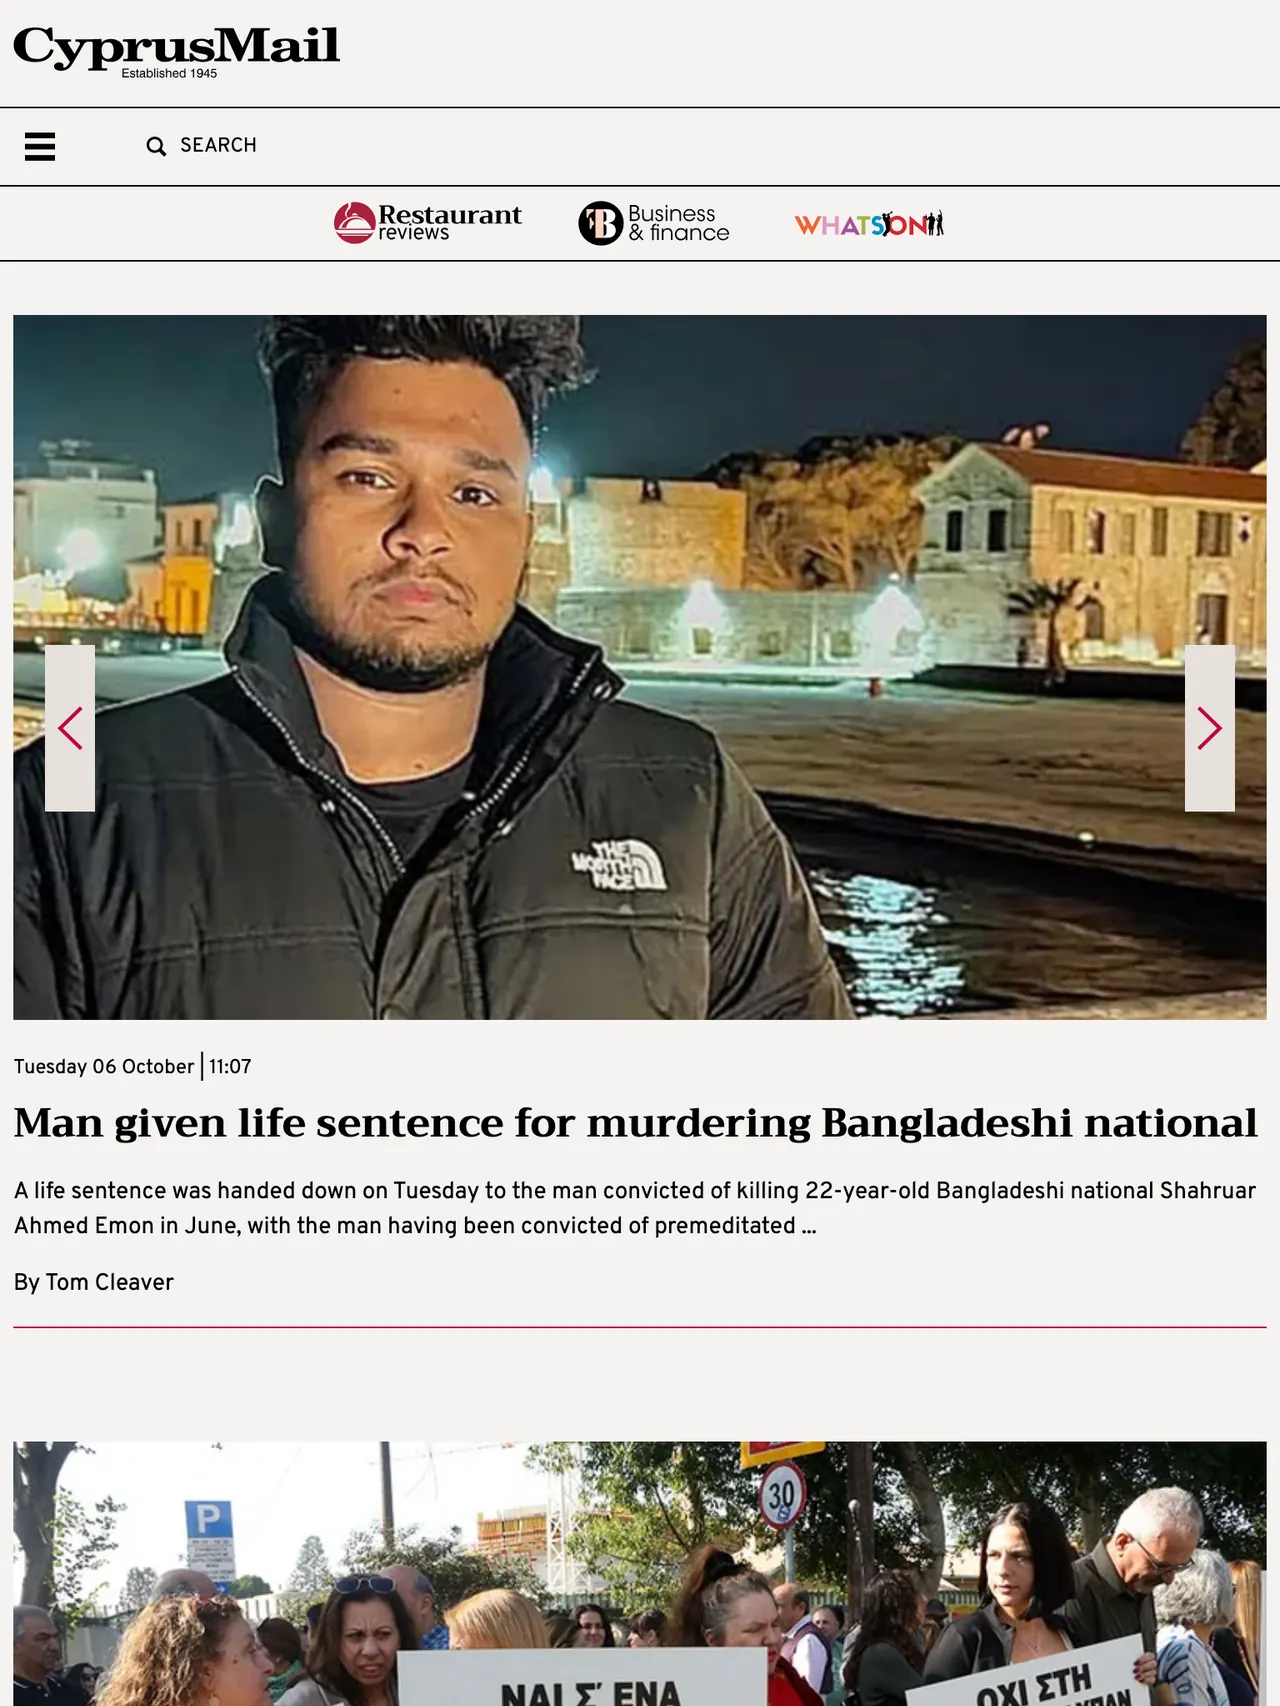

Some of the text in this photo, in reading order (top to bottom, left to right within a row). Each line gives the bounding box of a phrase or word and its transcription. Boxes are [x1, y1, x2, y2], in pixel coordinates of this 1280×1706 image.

[12, 26, 341, 72] CyprusMail
[121, 67, 218, 79] Established 1945
[180, 136, 257, 153] SEARCH
[378, 203, 523, 225] Restaurant
[629, 204, 716, 223] Business
[378, 223, 450, 241] reviews
[628, 222, 730, 242] & finance
[13, 1057, 252, 1078] Tuesday 06 October 11:07
[13, 1106, 1259, 1144] Man given life sentence for murdering Bangladeshi national
[13, 1180, 1257, 1204] A life sentence was handed down on Tuesday to the man convicted of killing 22-year-old Bangladeshi national Shahruar
[13, 1215, 88, 1235] Ahmed
[95, 1215, 154, 1235] Emon
[160, 1215, 178, 1234] in
[184, 1215, 242, 1238] June,
[247, 1215, 291, 1235] with
[296, 1215, 331, 1235] the
[337, 1219, 382, 1235] man
[388, 1215, 457, 1239] having
[464, 1215, 515, 1235] been
[521, 1215, 622, 1235] convicted
[628, 1215, 650, 1235] of
[655, 1215, 795, 1239] premeditated
[14, 1272, 175, 1296] By Tom Cleaver
[768, 1480, 795, 1510] 30
[197, 1504, 221, 1534] P
[1035, 1663, 1092, 1702] ΣΤΗ
